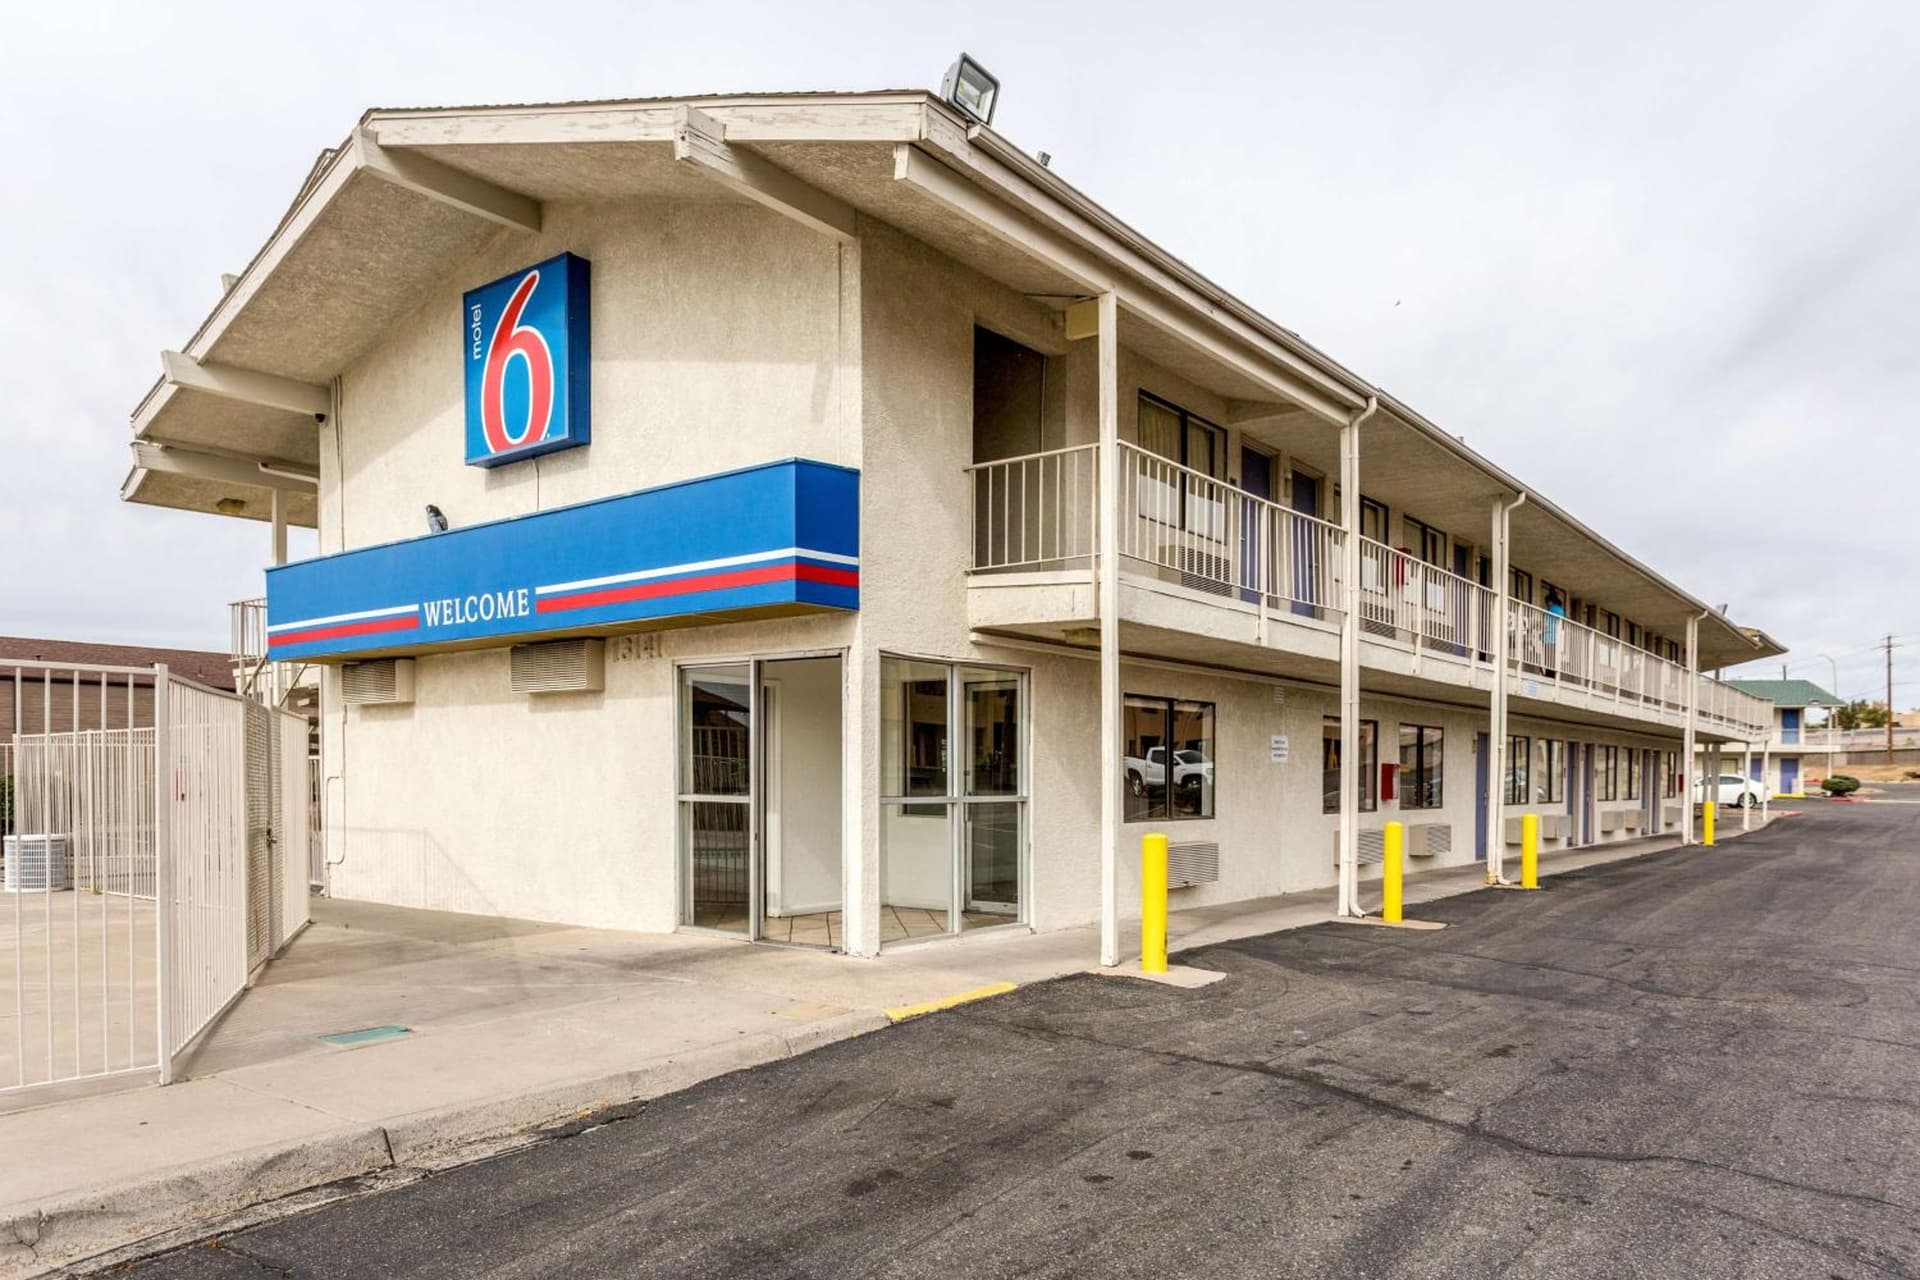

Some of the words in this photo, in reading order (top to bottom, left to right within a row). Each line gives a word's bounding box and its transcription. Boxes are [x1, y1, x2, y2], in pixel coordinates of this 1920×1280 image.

[471, 303, 482, 360] motel
[481, 269, 555, 453] 6
[424, 588, 529, 627] WELCOME
